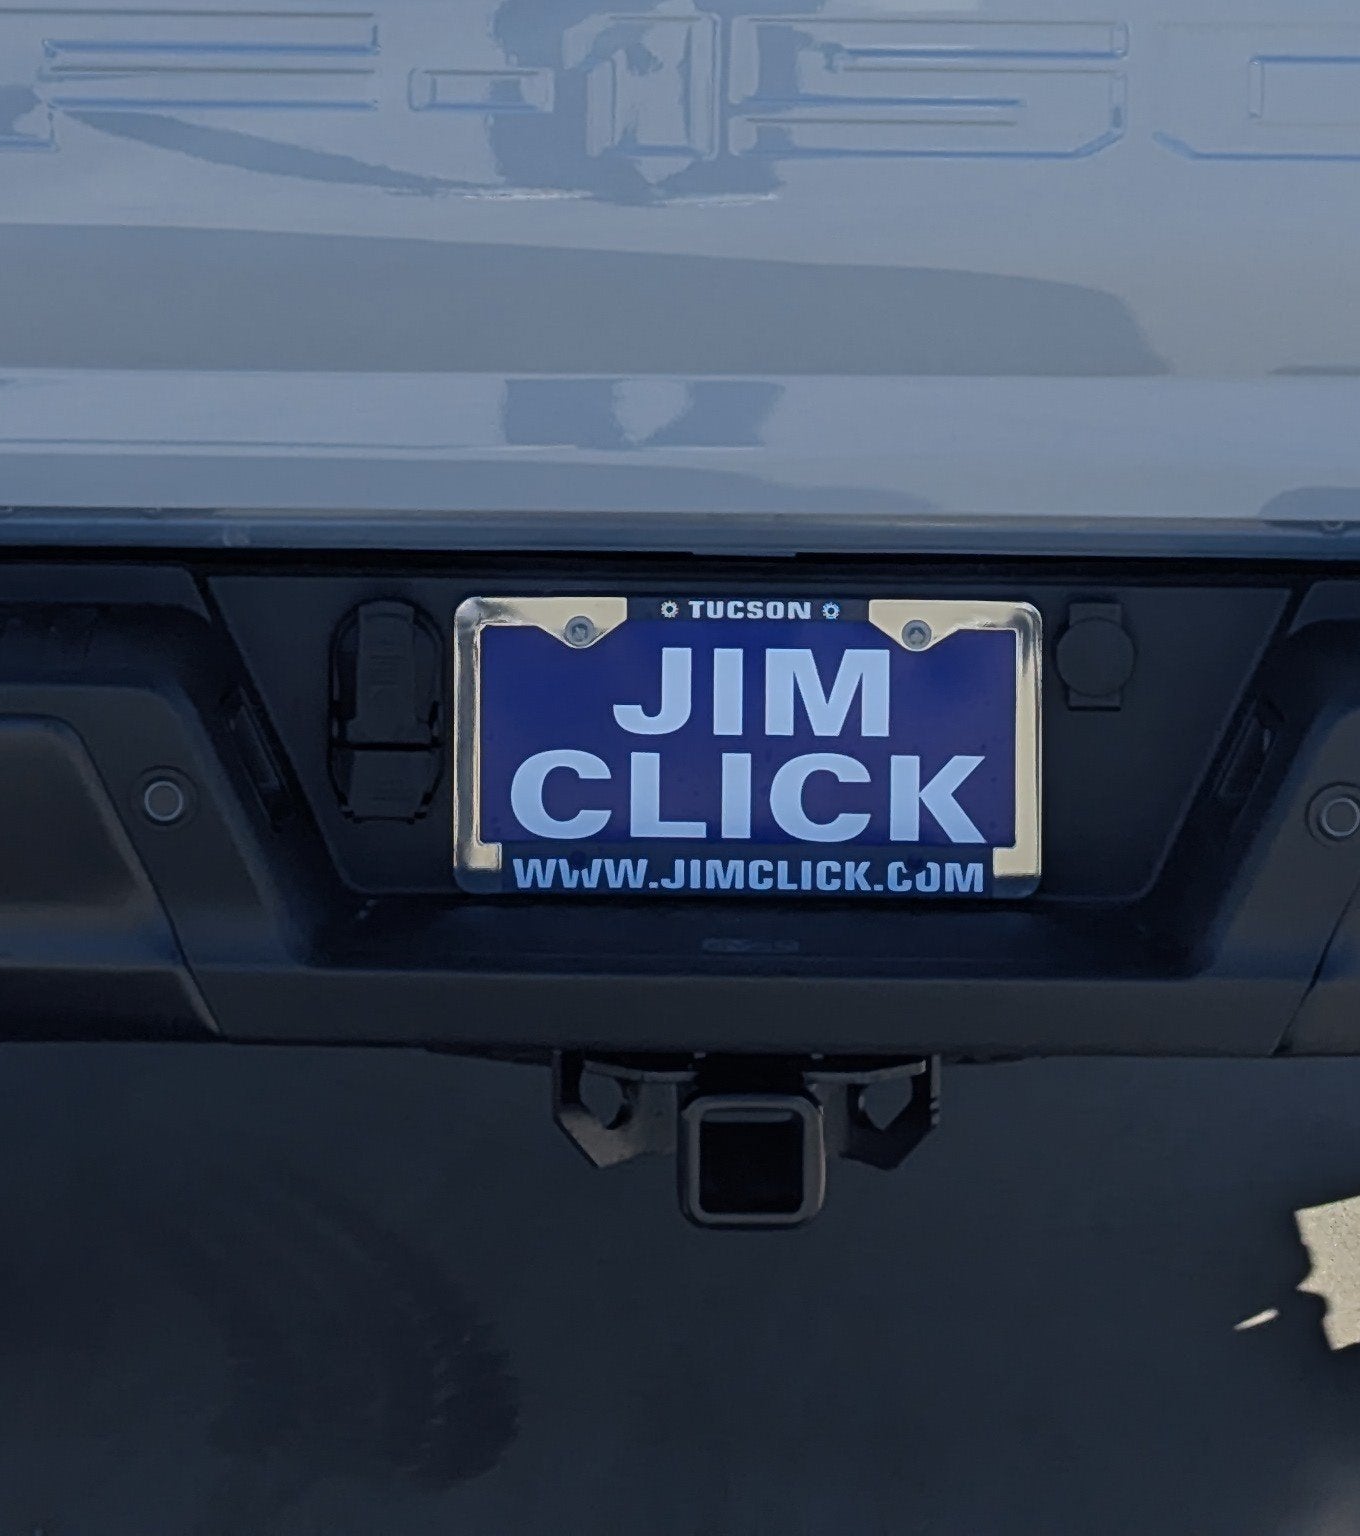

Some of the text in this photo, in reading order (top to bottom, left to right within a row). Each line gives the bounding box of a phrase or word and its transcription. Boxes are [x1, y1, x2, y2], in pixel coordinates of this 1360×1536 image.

[687, 600, 812, 620] TUCSON
[612, 646, 891, 737] JIM
[509, 749, 987, 844] CLICK
[512, 857, 984, 893] WWW.JIMCLICK.COM
